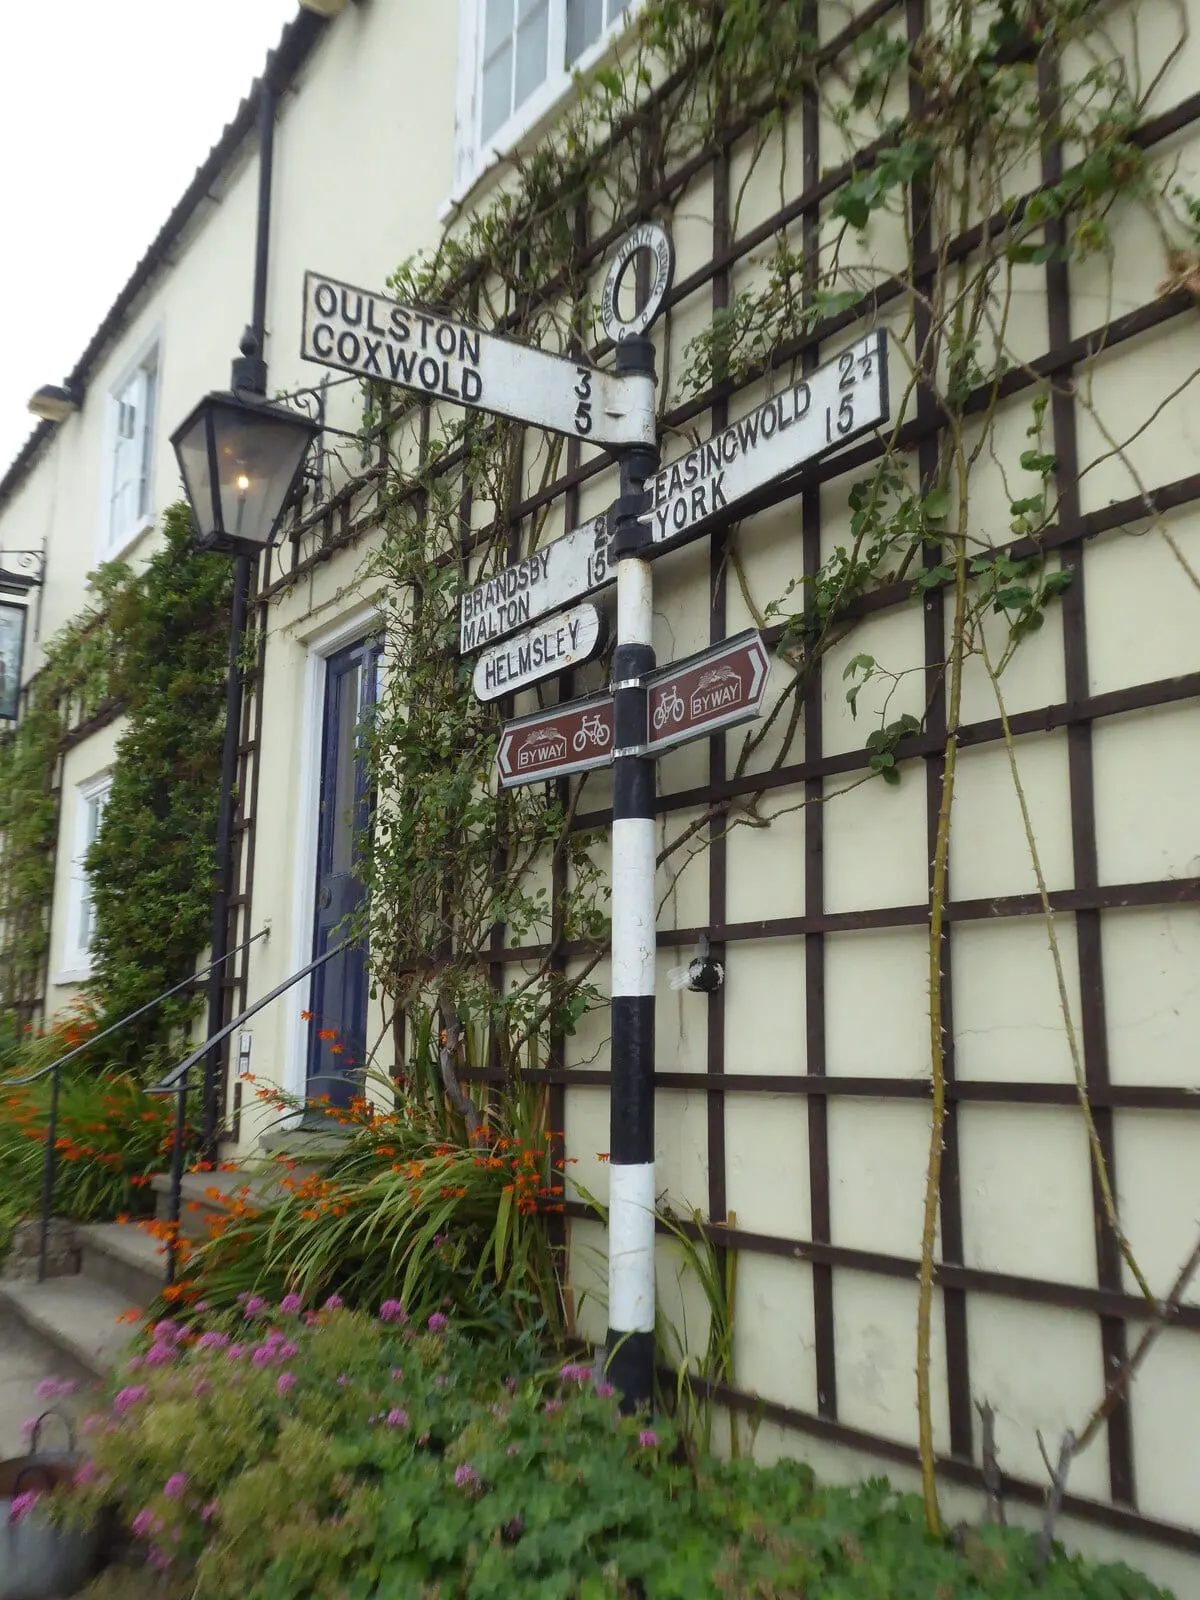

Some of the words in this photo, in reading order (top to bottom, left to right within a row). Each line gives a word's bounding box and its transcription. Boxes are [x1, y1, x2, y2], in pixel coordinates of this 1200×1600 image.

[312, 323, 483, 402] COXWOLD
[574, 403, 592, 435] 5
[314, 284, 480, 367] OULSTON
[574, 367, 592, 400] 3
[655, 382, 812, 502] EASINGWOLD
[656, 471, 728, 539] YORK
[826, 393, 854, 443] 15
[463, 591, 530, 650] MALTON
[587, 549, 606, 587] 15
[464, 549, 550, 622] BRANDSBY
[485, 619, 580, 690] HELMSLEY
[692, 683, 738, 715] BYWAY
[520, 742, 564, 766] BYWAY
